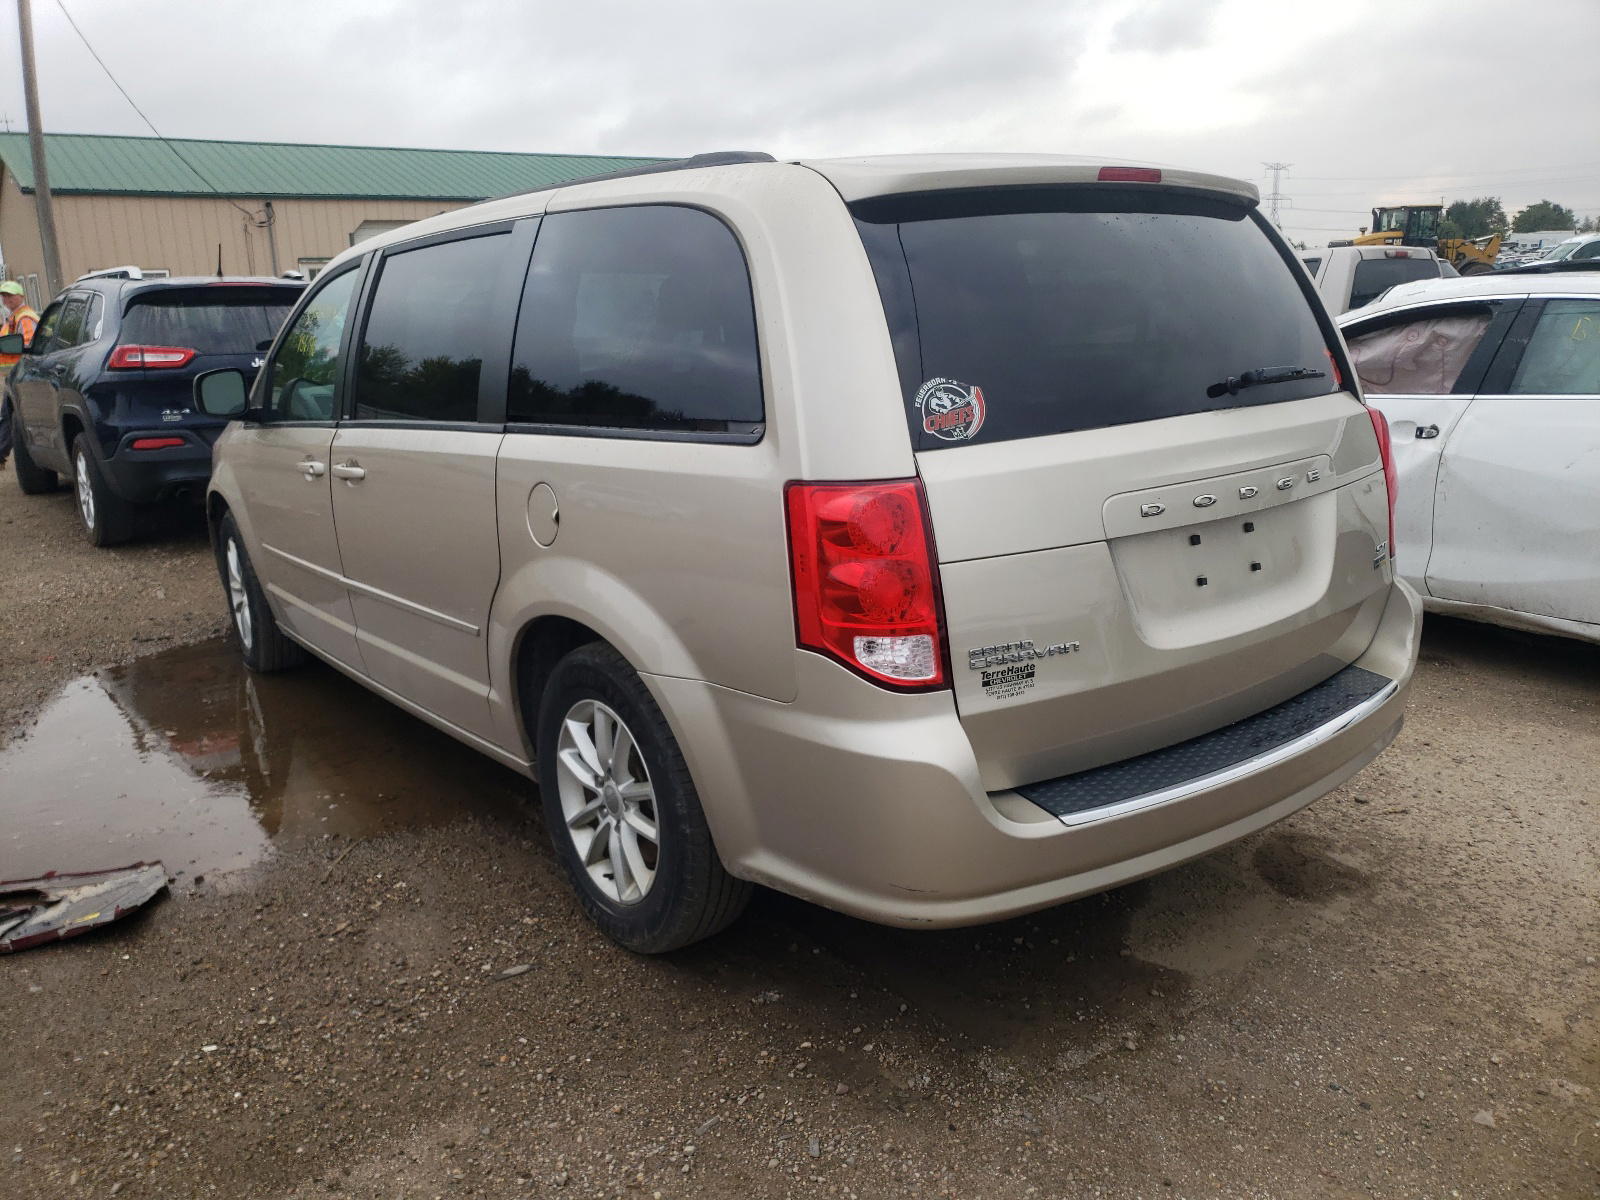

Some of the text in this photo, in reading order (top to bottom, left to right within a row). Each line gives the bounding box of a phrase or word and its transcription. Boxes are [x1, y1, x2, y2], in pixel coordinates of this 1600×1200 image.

[251, 357, 265, 368] Je
[924, 405, 976, 432] CHIEFS
[1141, 469, 1321, 517] DODGE
[989, 673, 1027, 686] CHEVROLET
